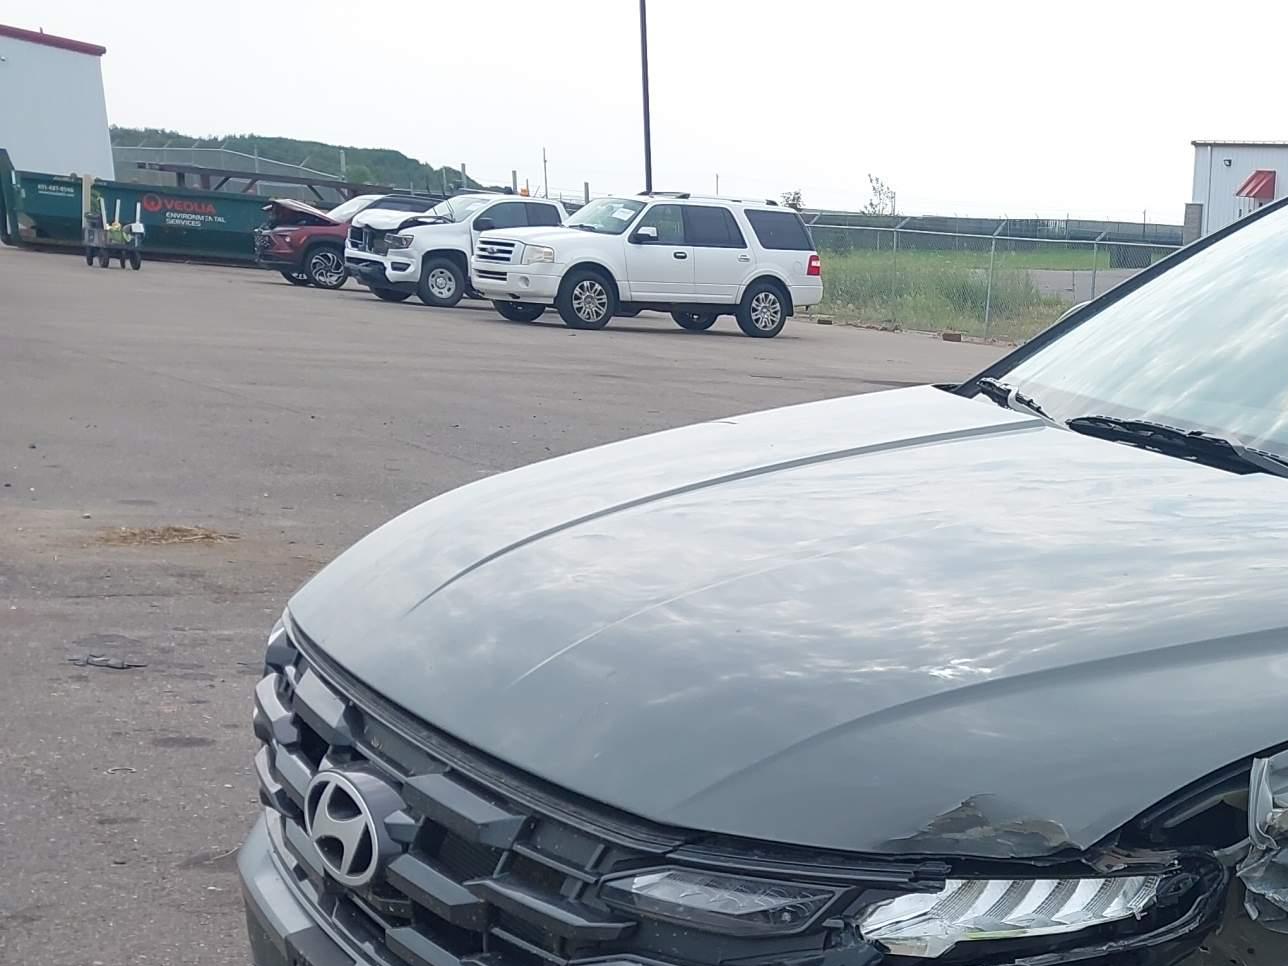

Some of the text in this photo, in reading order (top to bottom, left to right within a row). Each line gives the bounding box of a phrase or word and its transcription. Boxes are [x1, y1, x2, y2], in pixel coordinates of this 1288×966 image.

[164, 199, 216, 215] VEOLIA
[165, 211, 226, 223] ENVIRONMENTAL
[165, 218, 201, 227] SERVICES
